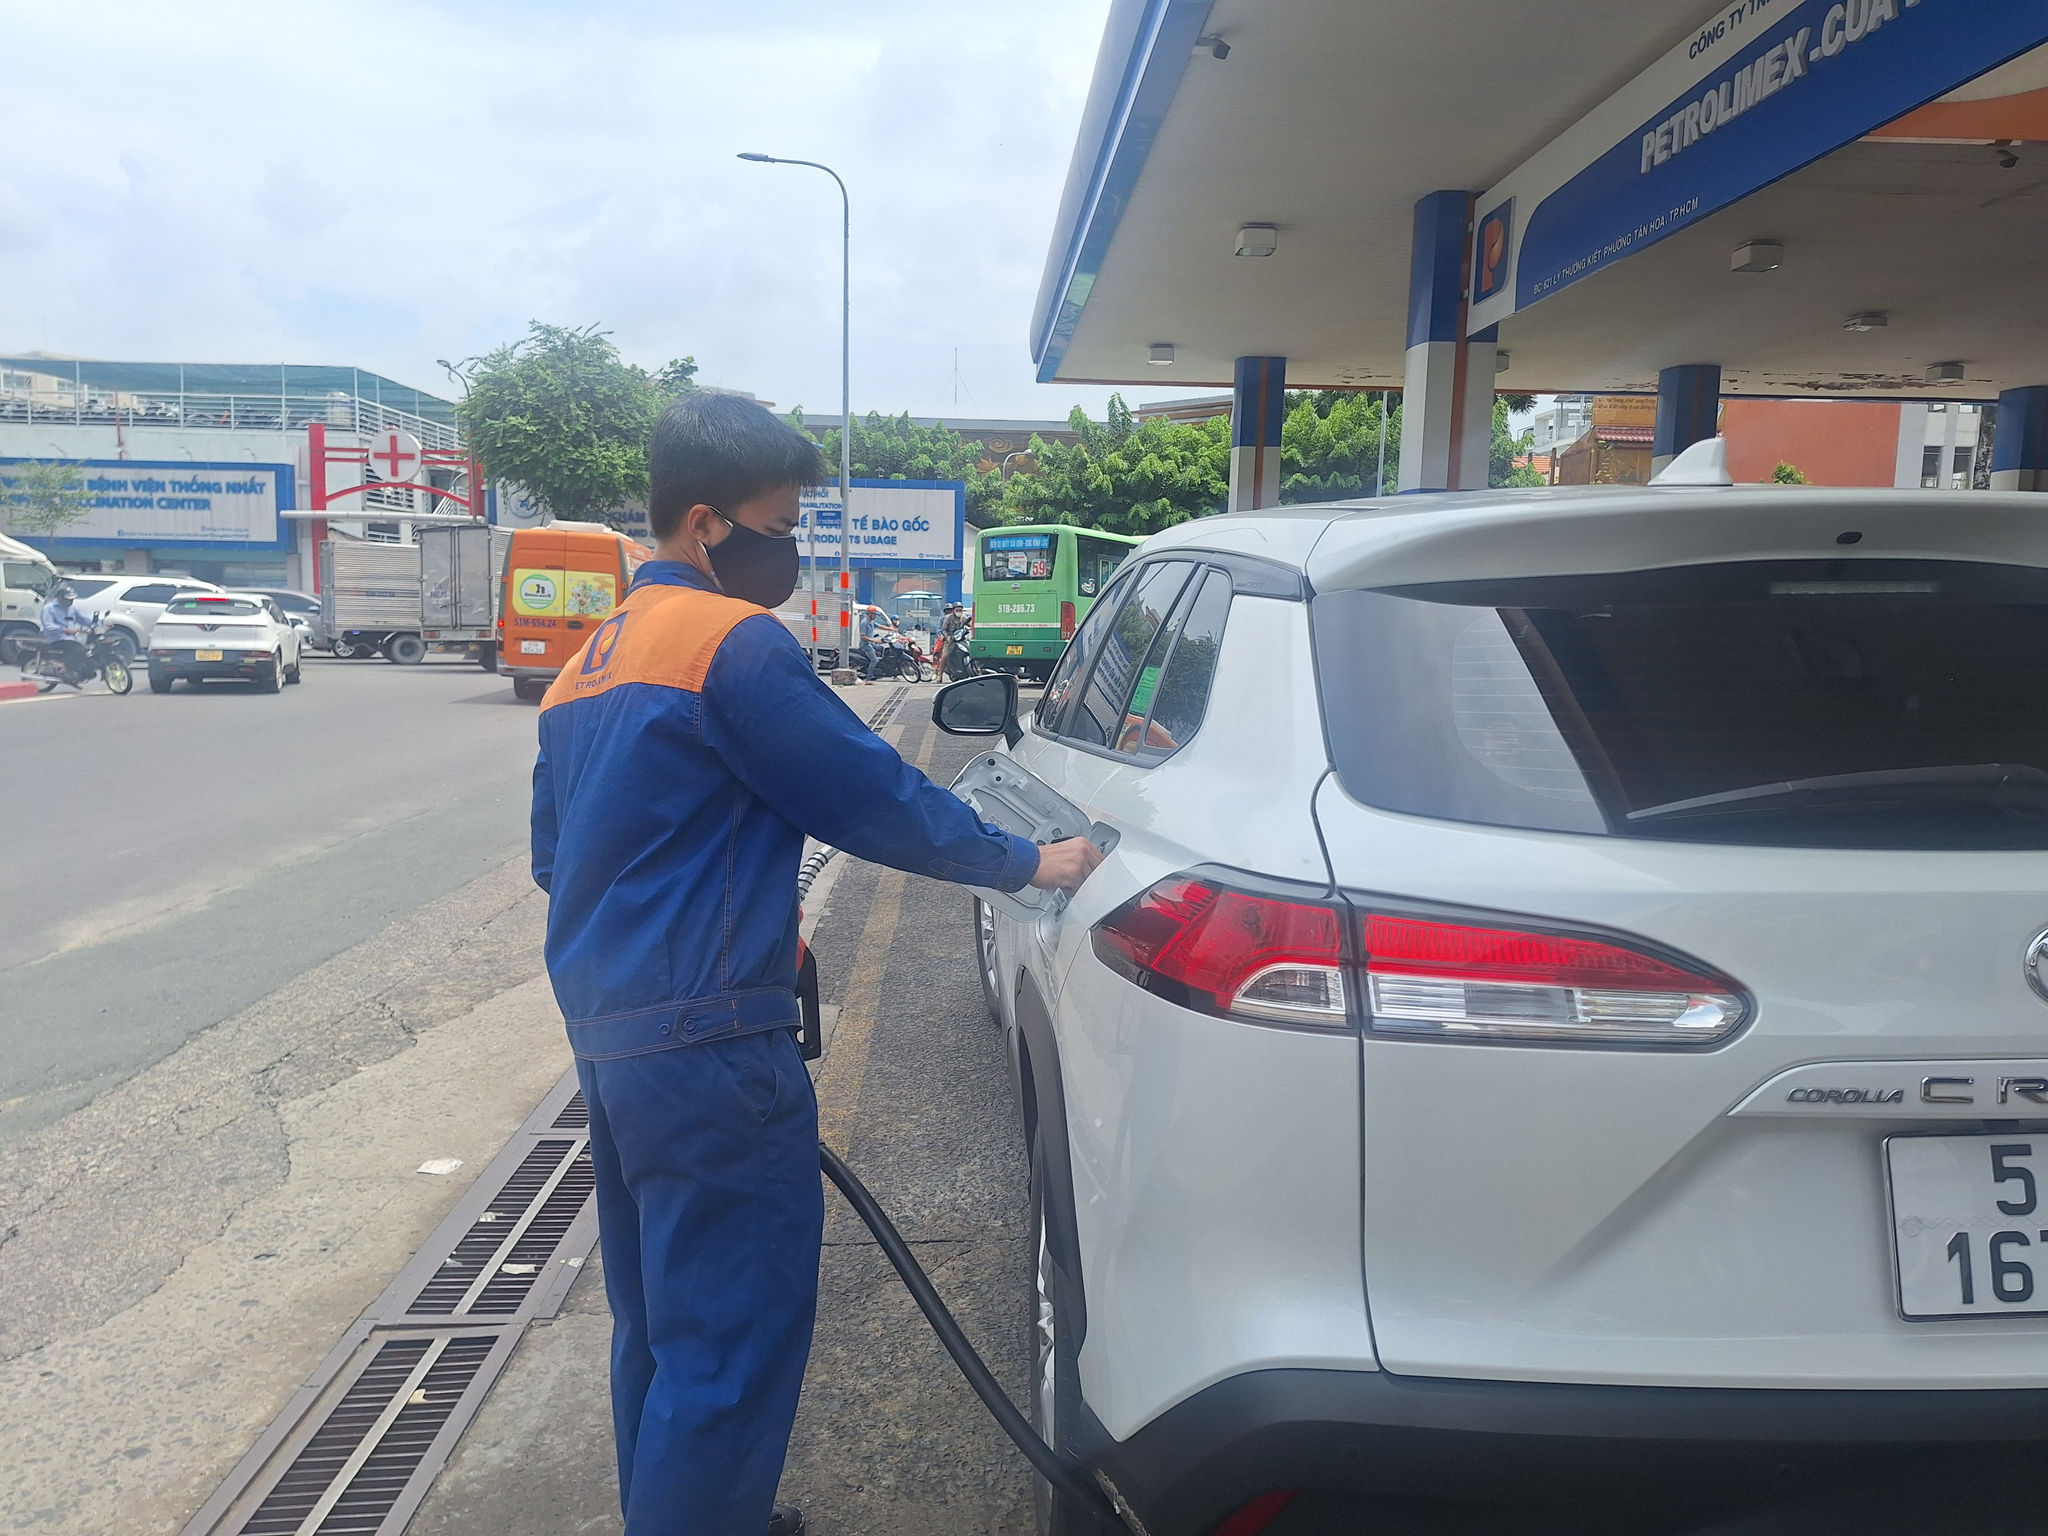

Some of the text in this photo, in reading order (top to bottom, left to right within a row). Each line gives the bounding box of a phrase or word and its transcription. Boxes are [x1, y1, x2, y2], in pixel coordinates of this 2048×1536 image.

[1689, 20, 1725, 60] CÔNG
[1729, 3, 1747, 30] TY
[1634, 224, 1649, 241] TÂN
[87, 476, 128, 493] BỆNH
[131, 476, 166, 494] VIỆN
[170, 474, 222, 494] THỐNG
[226, 475, 266, 495] NHẤT
[157, 498, 211, 511] CENTER
[610, 508, 646, 523] KHÁM
[852, 514, 930, 532] TẾ BÀO GỐC
[864, 535, 897, 545] USAGE
[1033, 561, 1045, 576] 59
[1786, 1088, 1904, 1104] COROLLA
[1990, 1144, 2037, 1217] 5
[1946, 1230, 2048, 1304] 16
